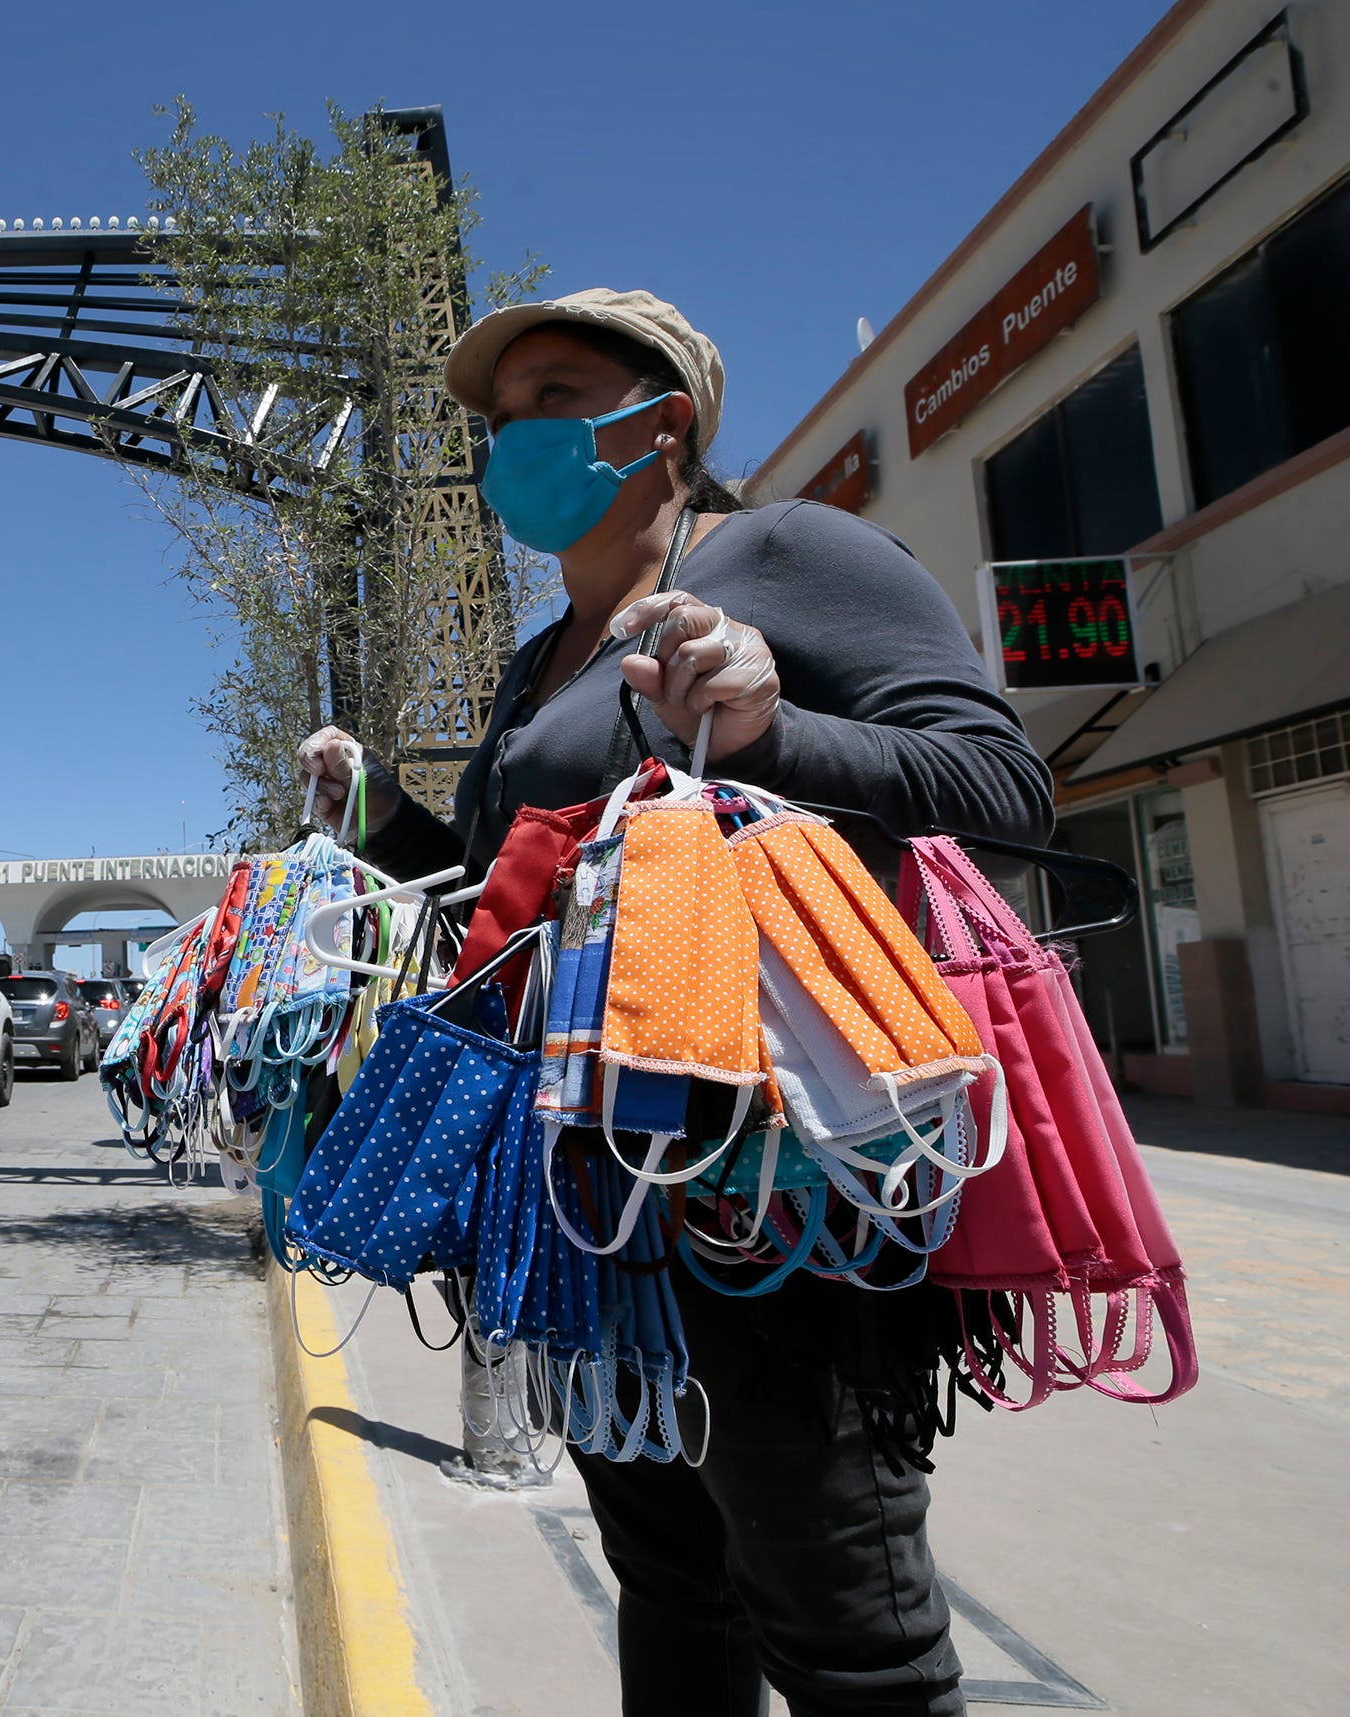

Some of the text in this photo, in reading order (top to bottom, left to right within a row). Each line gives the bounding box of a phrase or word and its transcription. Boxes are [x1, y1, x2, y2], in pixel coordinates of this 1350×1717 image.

[914, 261, 1078, 424] Cambios Puente
[997, 596, 1128, 661] 21.90
[22, 860, 95, 884] PUENTE
[100, 855, 239, 880] INTERNACION
